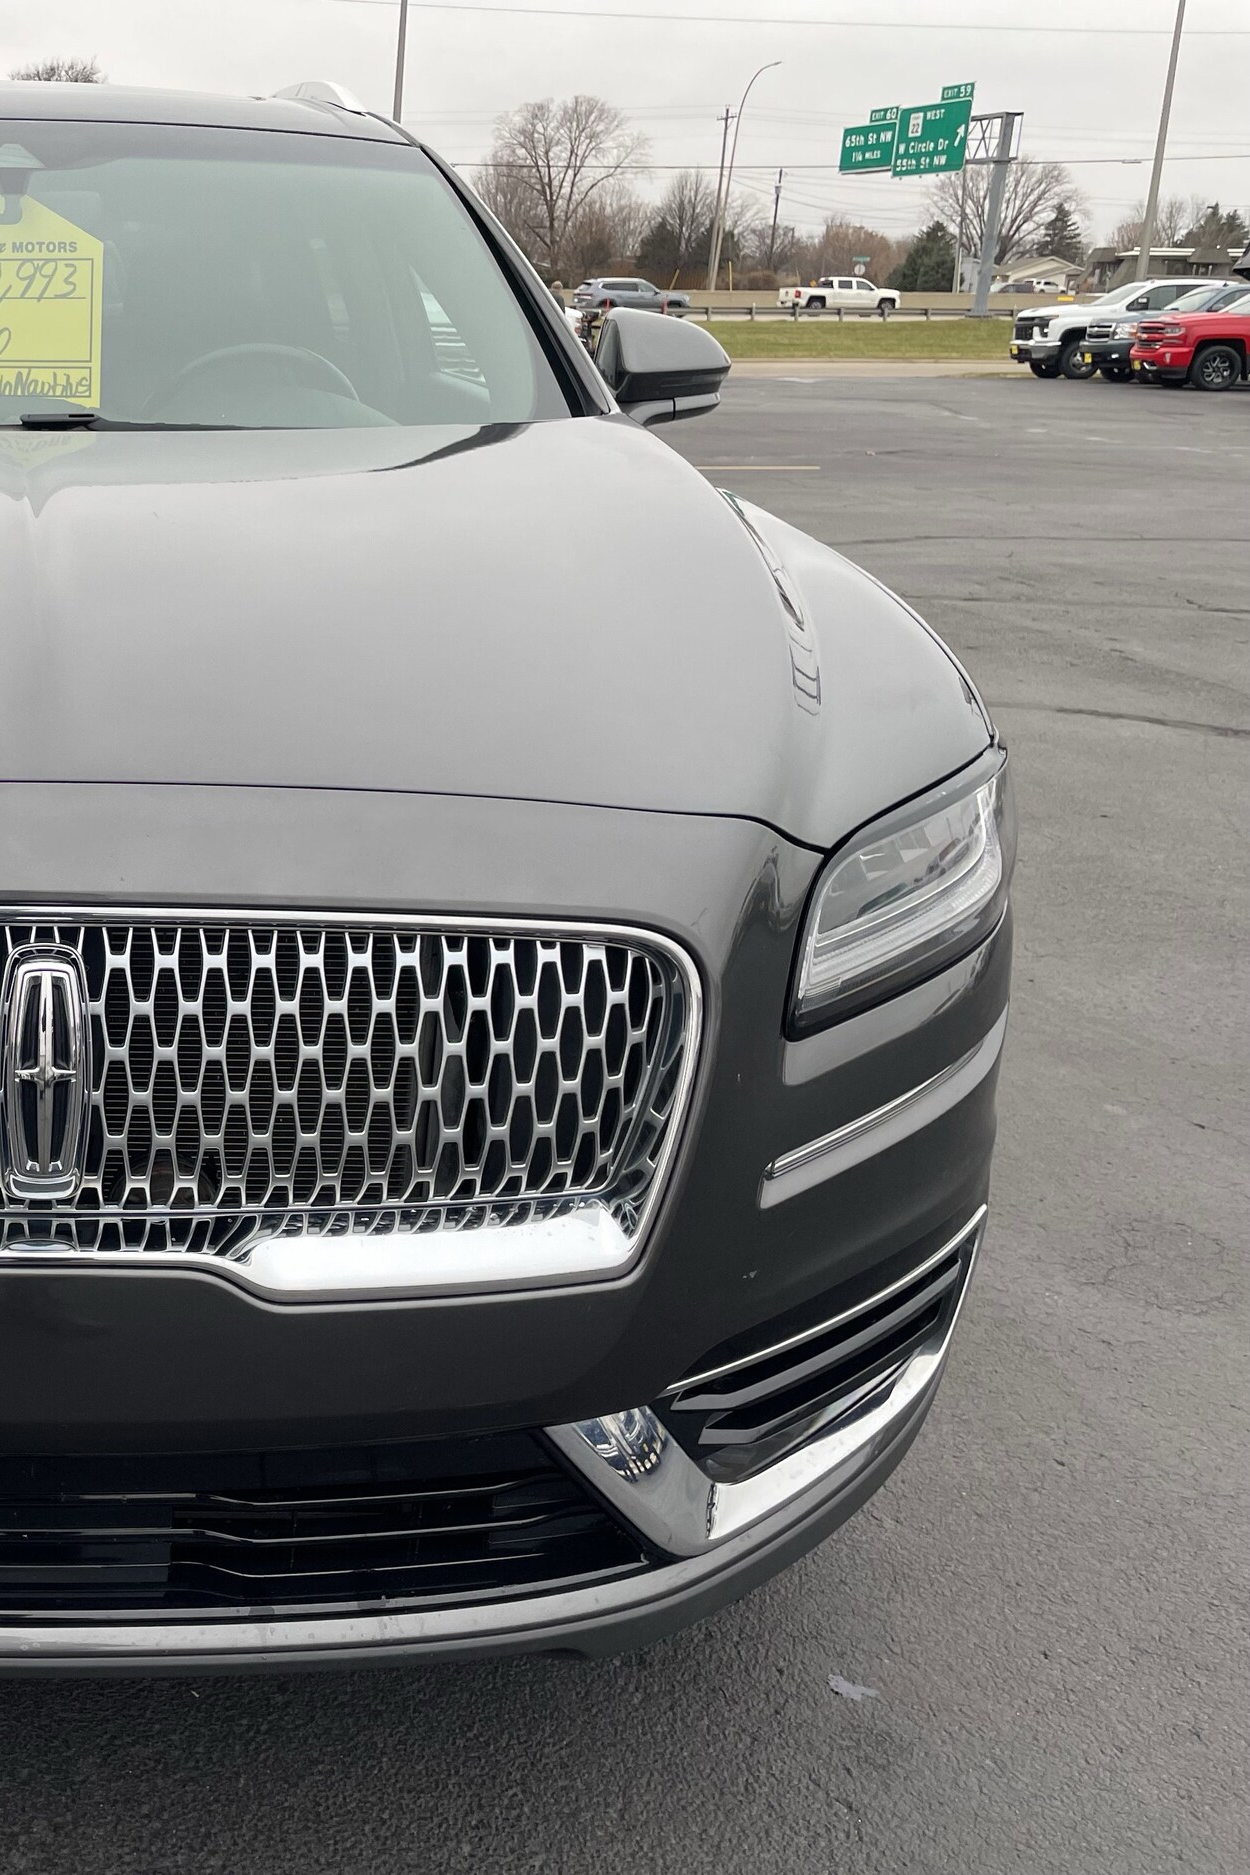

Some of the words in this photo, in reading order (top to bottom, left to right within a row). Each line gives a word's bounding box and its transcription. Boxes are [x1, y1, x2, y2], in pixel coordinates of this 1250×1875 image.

[943, 88, 958, 98] EXIT
[959, 85, 972, 97] 59
[872, 111, 884, 120] EXIT
[886, 108, 897, 120] 60
[926, 109, 945, 120] WEST
[910, 122, 920, 134] 22
[845, 134, 865, 147] 65th
[867, 132, 877, 145] St
[879, 130, 893, 143] NW
[898, 143, 906, 155] W
[909, 140, 934, 154] Circle
[937, 138, 949, 151] Dr
[864, 150, 881, 159] MILES
[896, 158, 916, 171] 55th
[920, 157, 930, 169] St
[933, 154, 947, 167] NW
[12, 241, 78, 254] MOTORS
